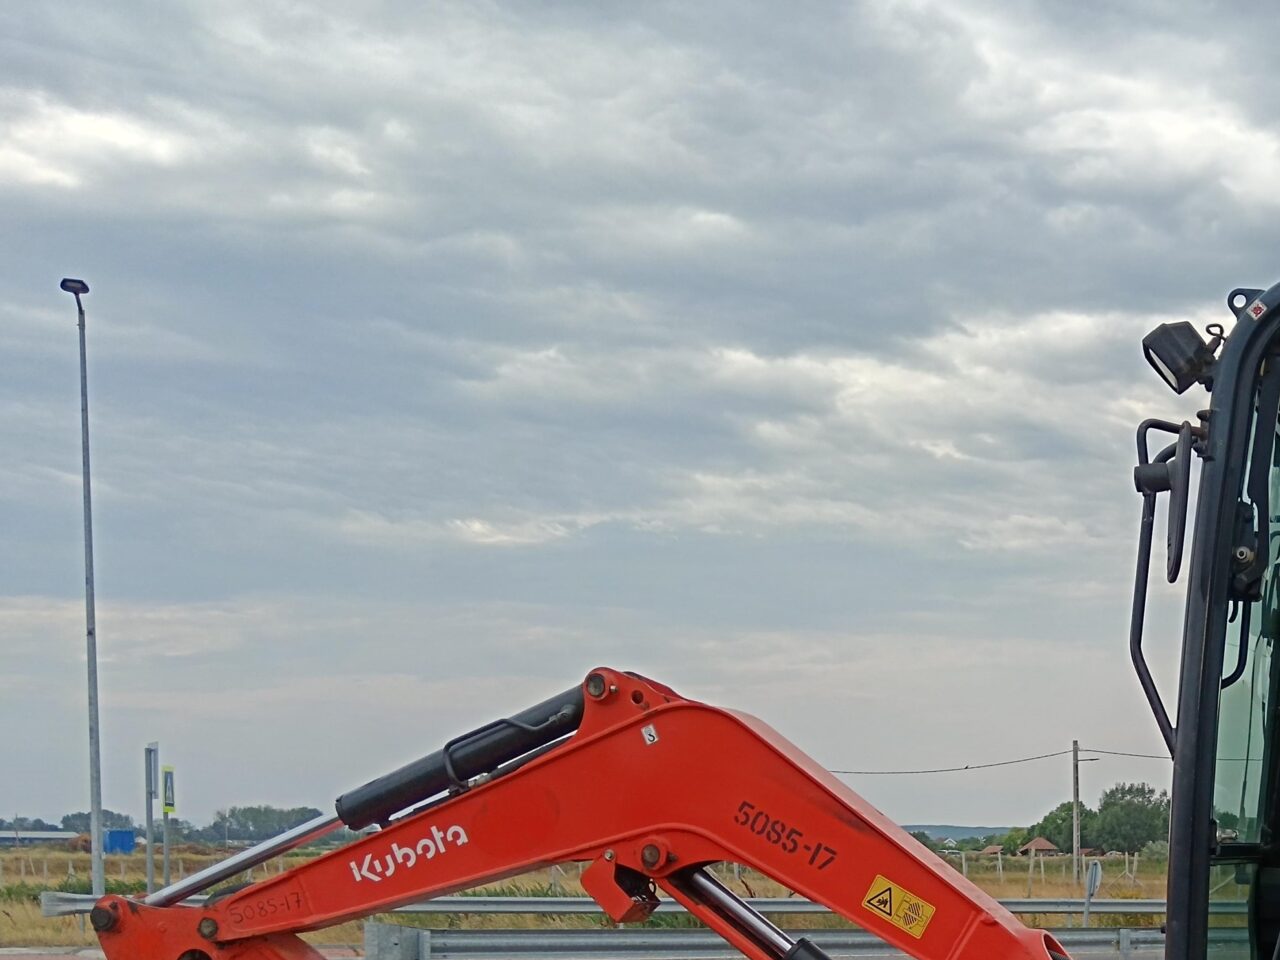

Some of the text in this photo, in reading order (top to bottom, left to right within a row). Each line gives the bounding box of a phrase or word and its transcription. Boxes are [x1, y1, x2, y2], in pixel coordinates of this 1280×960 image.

[349, 825, 469, 882] Kubota
[734, 800, 837, 870] 5085-17
[229, 891, 301, 924] 5085-17
